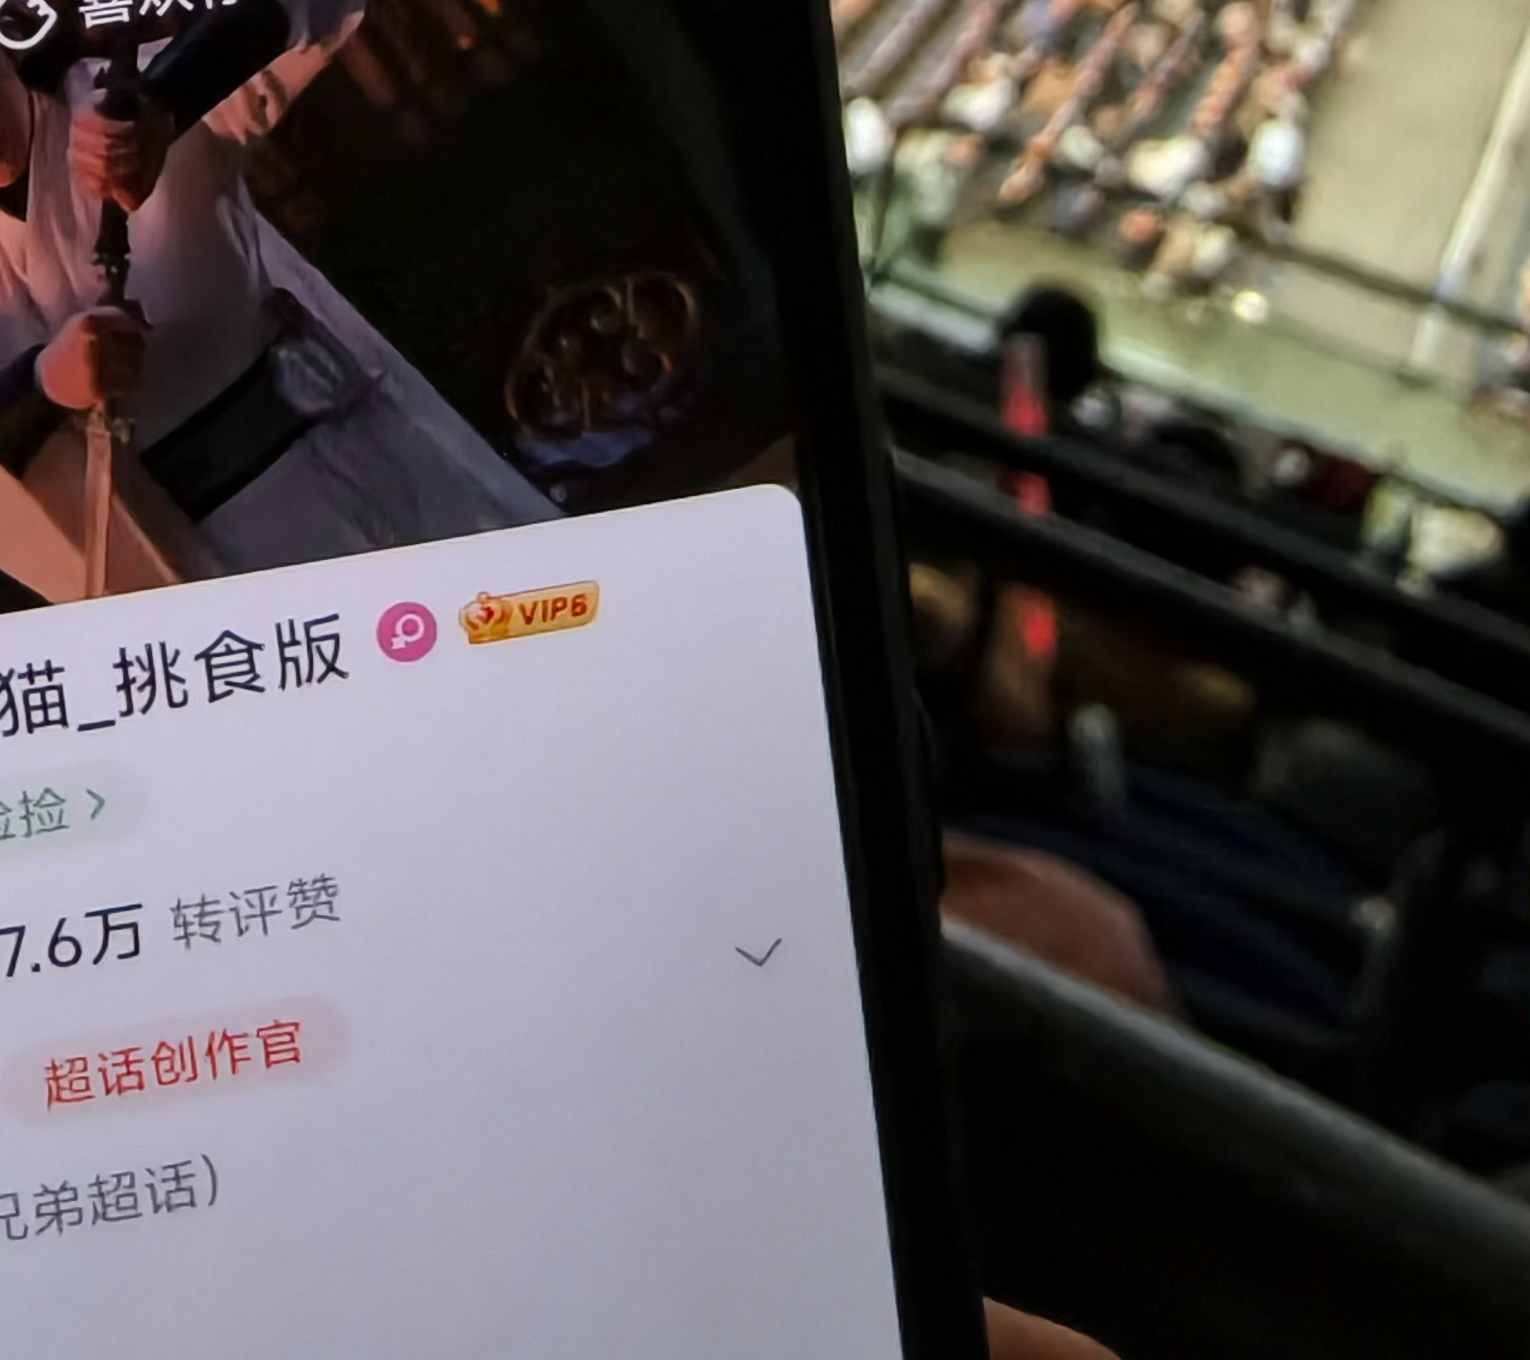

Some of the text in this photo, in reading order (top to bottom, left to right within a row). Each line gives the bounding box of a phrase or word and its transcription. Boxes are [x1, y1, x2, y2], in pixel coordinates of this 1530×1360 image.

[520, 593, 588, 625] VIP6
[170, 874, 342, 951] 转评赞
[43, 1019, 303, 1113] 超话创作官
